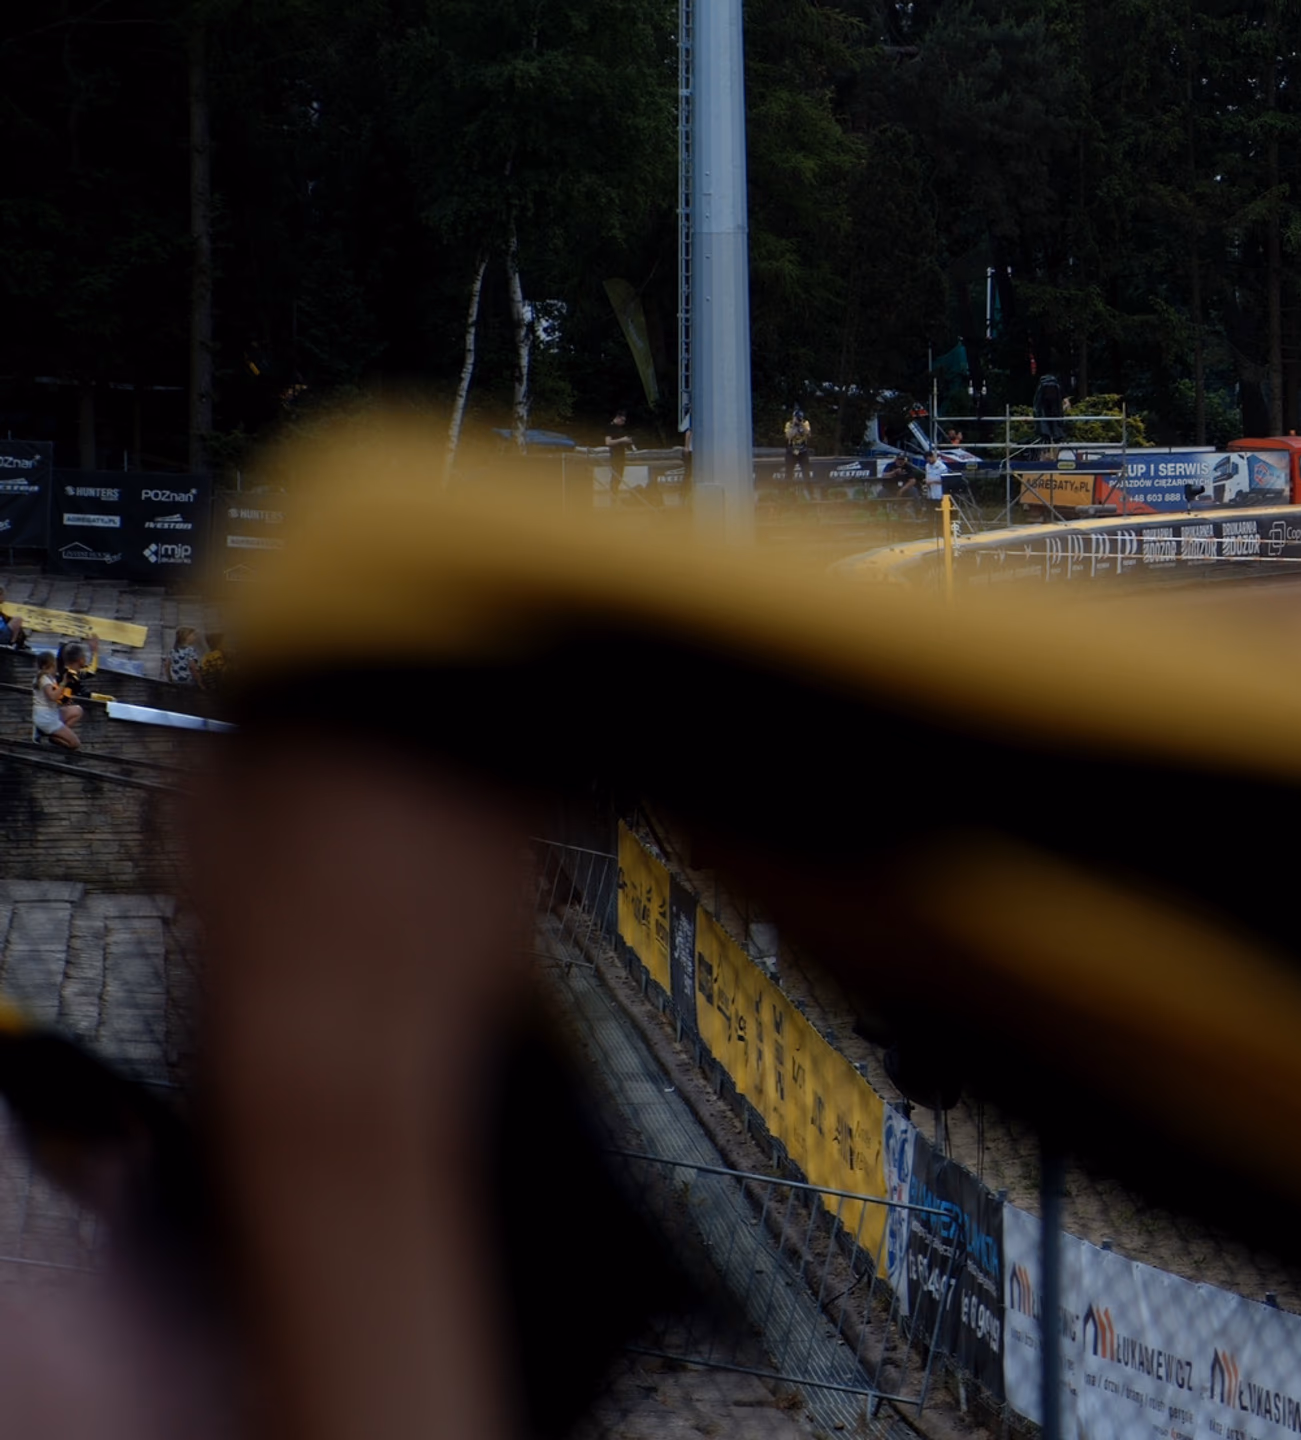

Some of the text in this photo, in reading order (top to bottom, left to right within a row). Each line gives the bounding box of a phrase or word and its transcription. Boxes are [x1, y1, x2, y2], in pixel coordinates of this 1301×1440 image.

[1150, 464, 1155, 476] I
[1158, 463, 1210, 477] SERWIS
[75, 487, 121, 498] HUNTERS
[1146, 493, 1162, 502] 603
[161, 544, 192, 558] mjp
